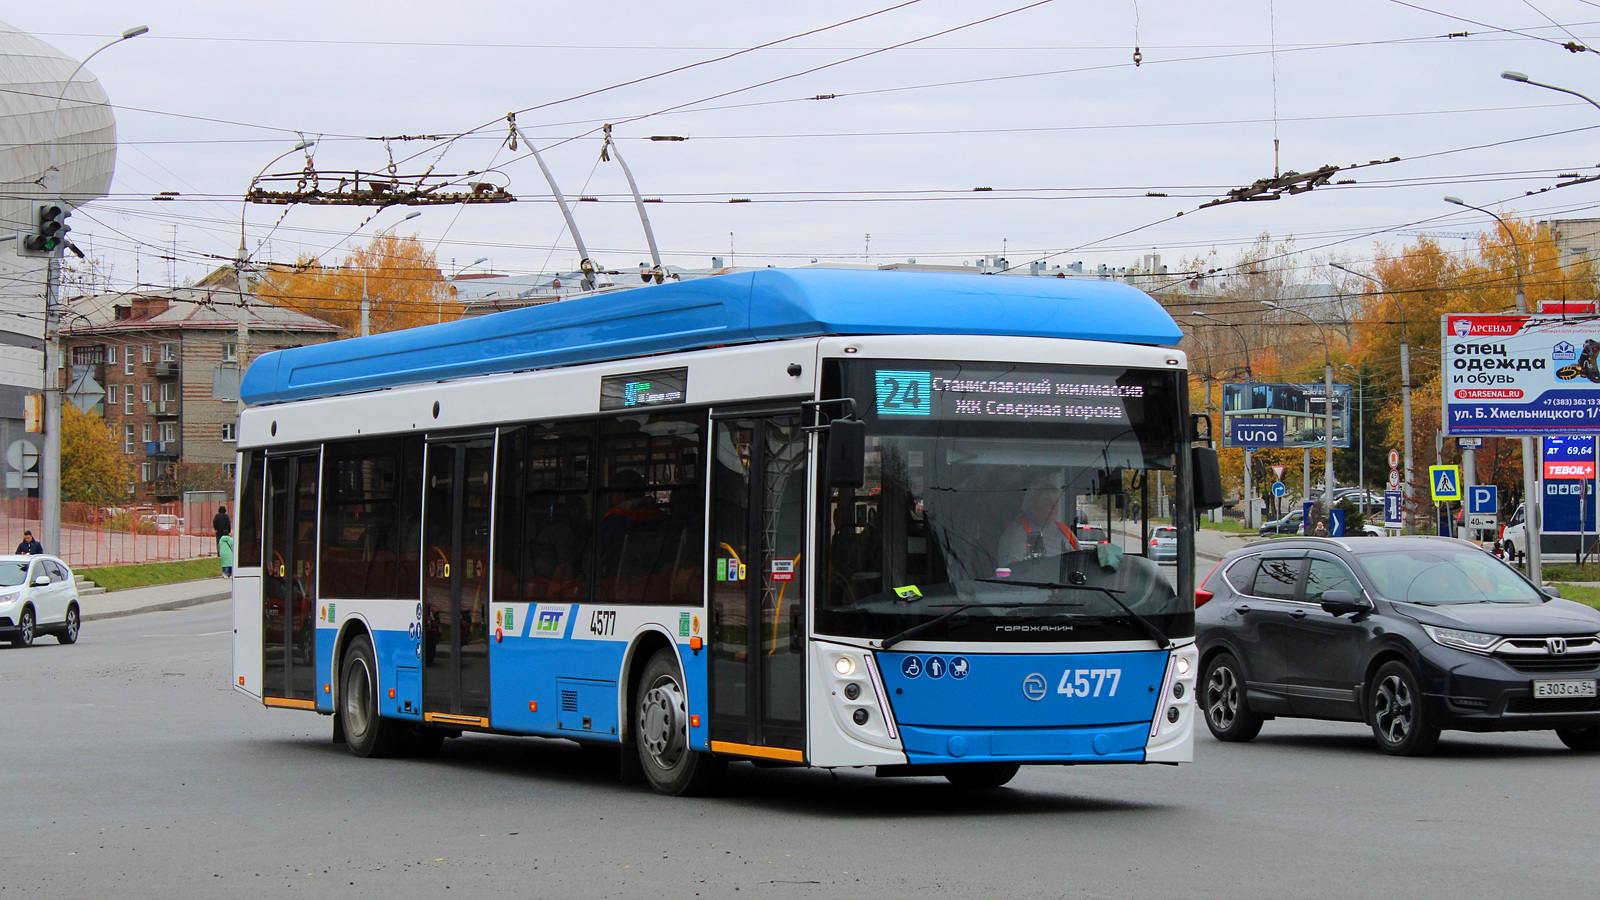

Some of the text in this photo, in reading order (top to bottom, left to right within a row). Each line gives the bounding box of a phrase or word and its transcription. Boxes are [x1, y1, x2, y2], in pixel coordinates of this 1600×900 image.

[1471, 325, 1512, 333] АРСЕНАЛ
[1453, 344, 1507, 357] спец
[1453, 358, 1546, 371] одежда
[1453, 372, 1515, 385] и обувь
[884, 378, 921, 409] 24
[932, 377, 1144, 398] Станиславский жилмассив
[1468, 390, 1520, 398] 1ARSENAL.RU
[1553, 398, 1572, 406] (383)
[955, 399, 1122, 420] ЖК Северная корона
[1454, 409, 1473, 421] ул.
[1475, 407, 1488, 419] Б.
[1490, 407, 1585, 421] Хмельницкого
[1567, 446, 1592, 456] 69,64
[1475, 489, 1491, 512] P
[590, 610, 617, 636] 4577
[1057, 668, 1122, 698] 4577
